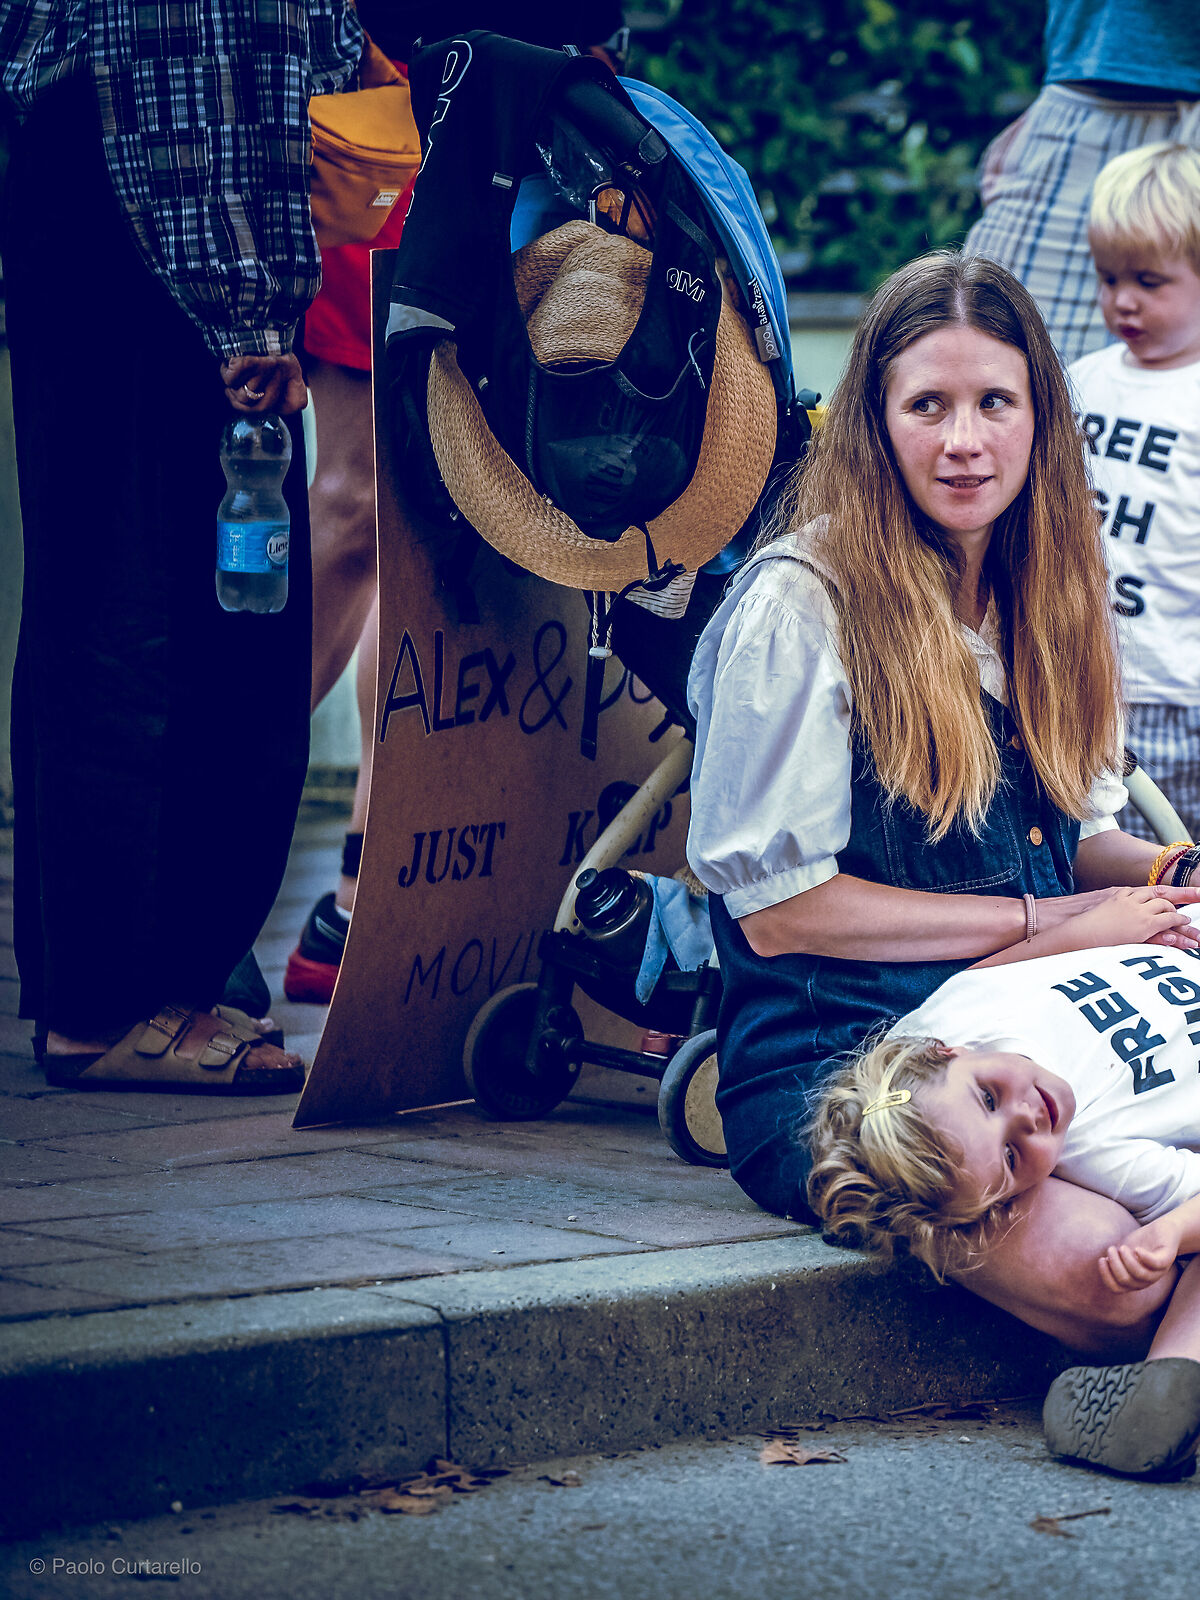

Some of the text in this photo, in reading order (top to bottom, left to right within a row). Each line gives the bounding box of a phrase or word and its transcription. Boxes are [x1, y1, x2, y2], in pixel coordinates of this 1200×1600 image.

[762, 331, 776, 358] YOYO
[1074, 412, 1179, 473] REE
[1113, 574, 1147, 617] S
[379, 627, 517, 743] ALEX
[518, 620, 573, 734] &
[398, 800, 673, 888] JUST KP
[404, 930, 535, 1004] MOVI
[1050, 971, 1176, 1095] FREE
